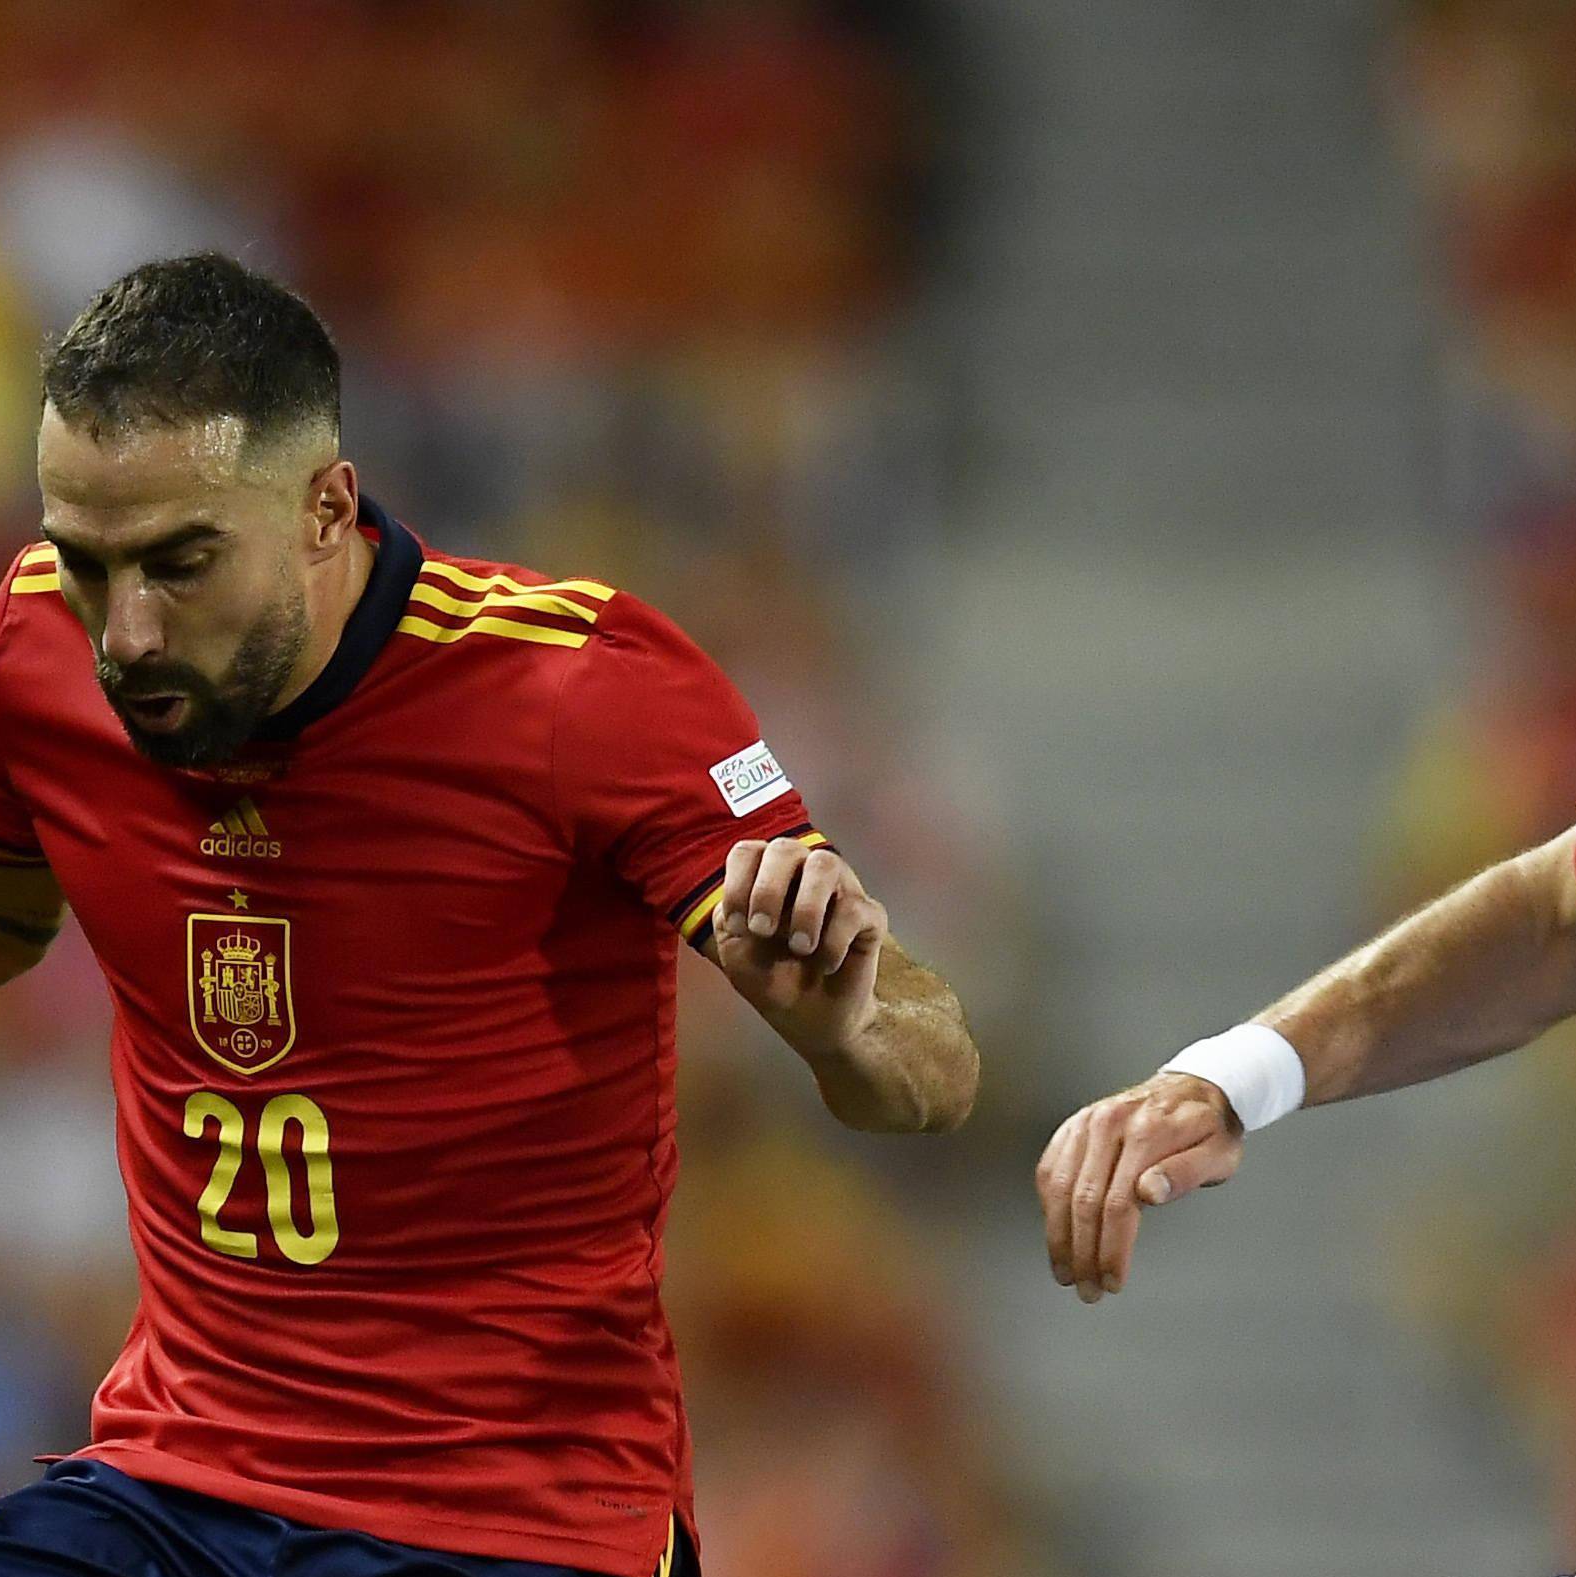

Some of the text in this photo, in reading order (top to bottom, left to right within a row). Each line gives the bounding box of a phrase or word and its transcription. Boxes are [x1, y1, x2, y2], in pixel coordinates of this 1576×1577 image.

[717, 759, 744, 780] UEFA
[200, 834, 282, 858] adidas
[183, 1091, 340, 1265] 20
